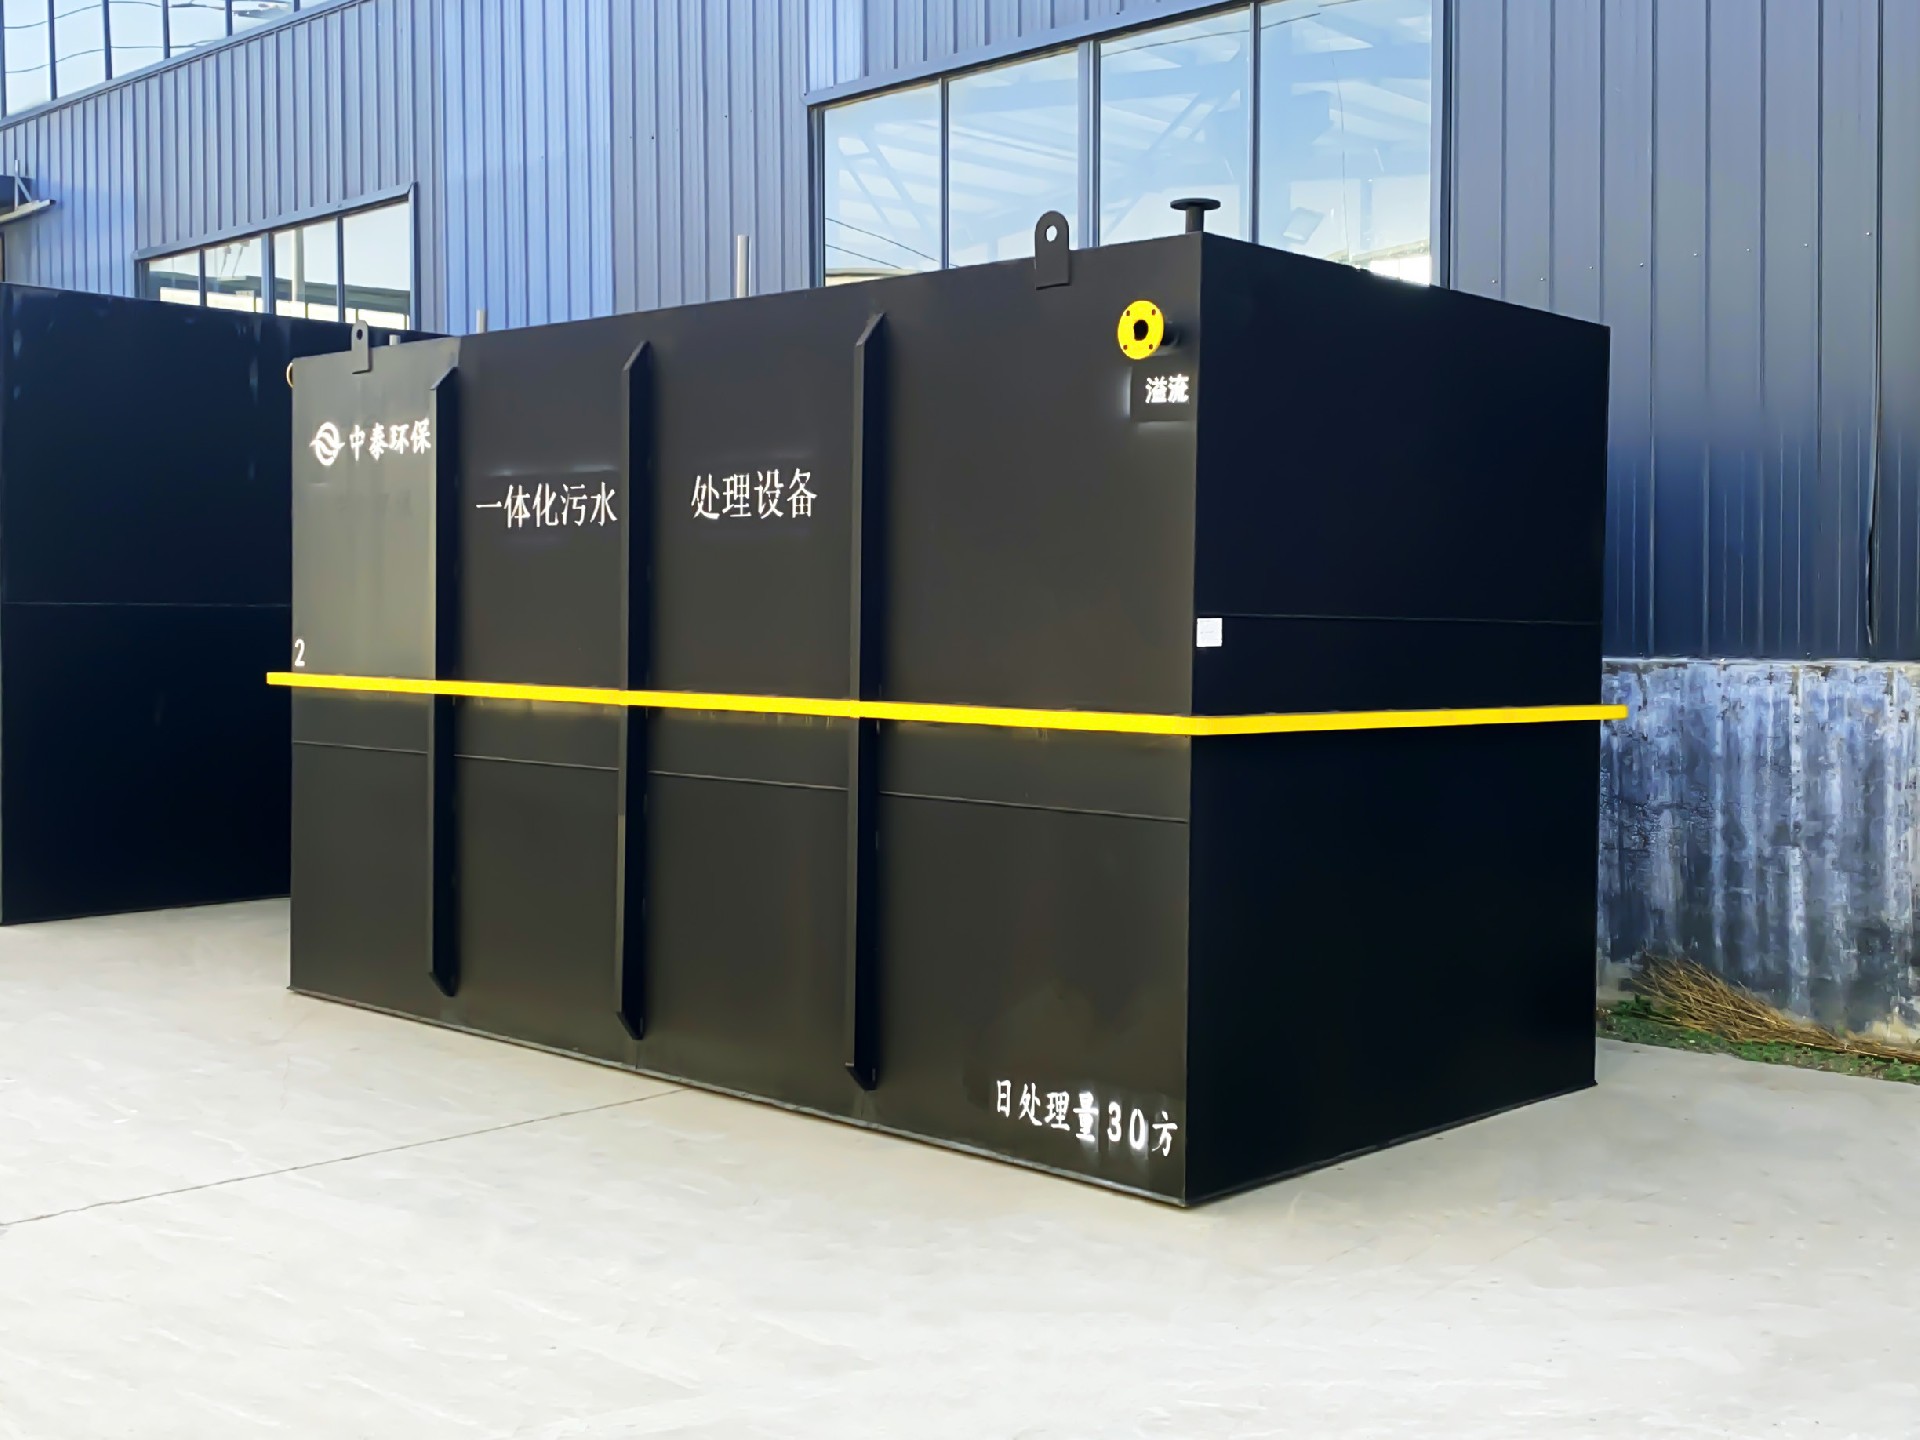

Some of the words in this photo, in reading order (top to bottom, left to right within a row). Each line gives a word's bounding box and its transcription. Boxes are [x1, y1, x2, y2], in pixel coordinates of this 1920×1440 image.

[1144, 373, 1190, 404] 溢流
[349, 417, 432, 462] 中泰环保
[475, 481, 618, 529] 一体化污水
[690, 467, 818, 520] 处理设备
[294, 638, 306, 667] 2
[996, 1079, 1179, 1157] 日处理量30方
